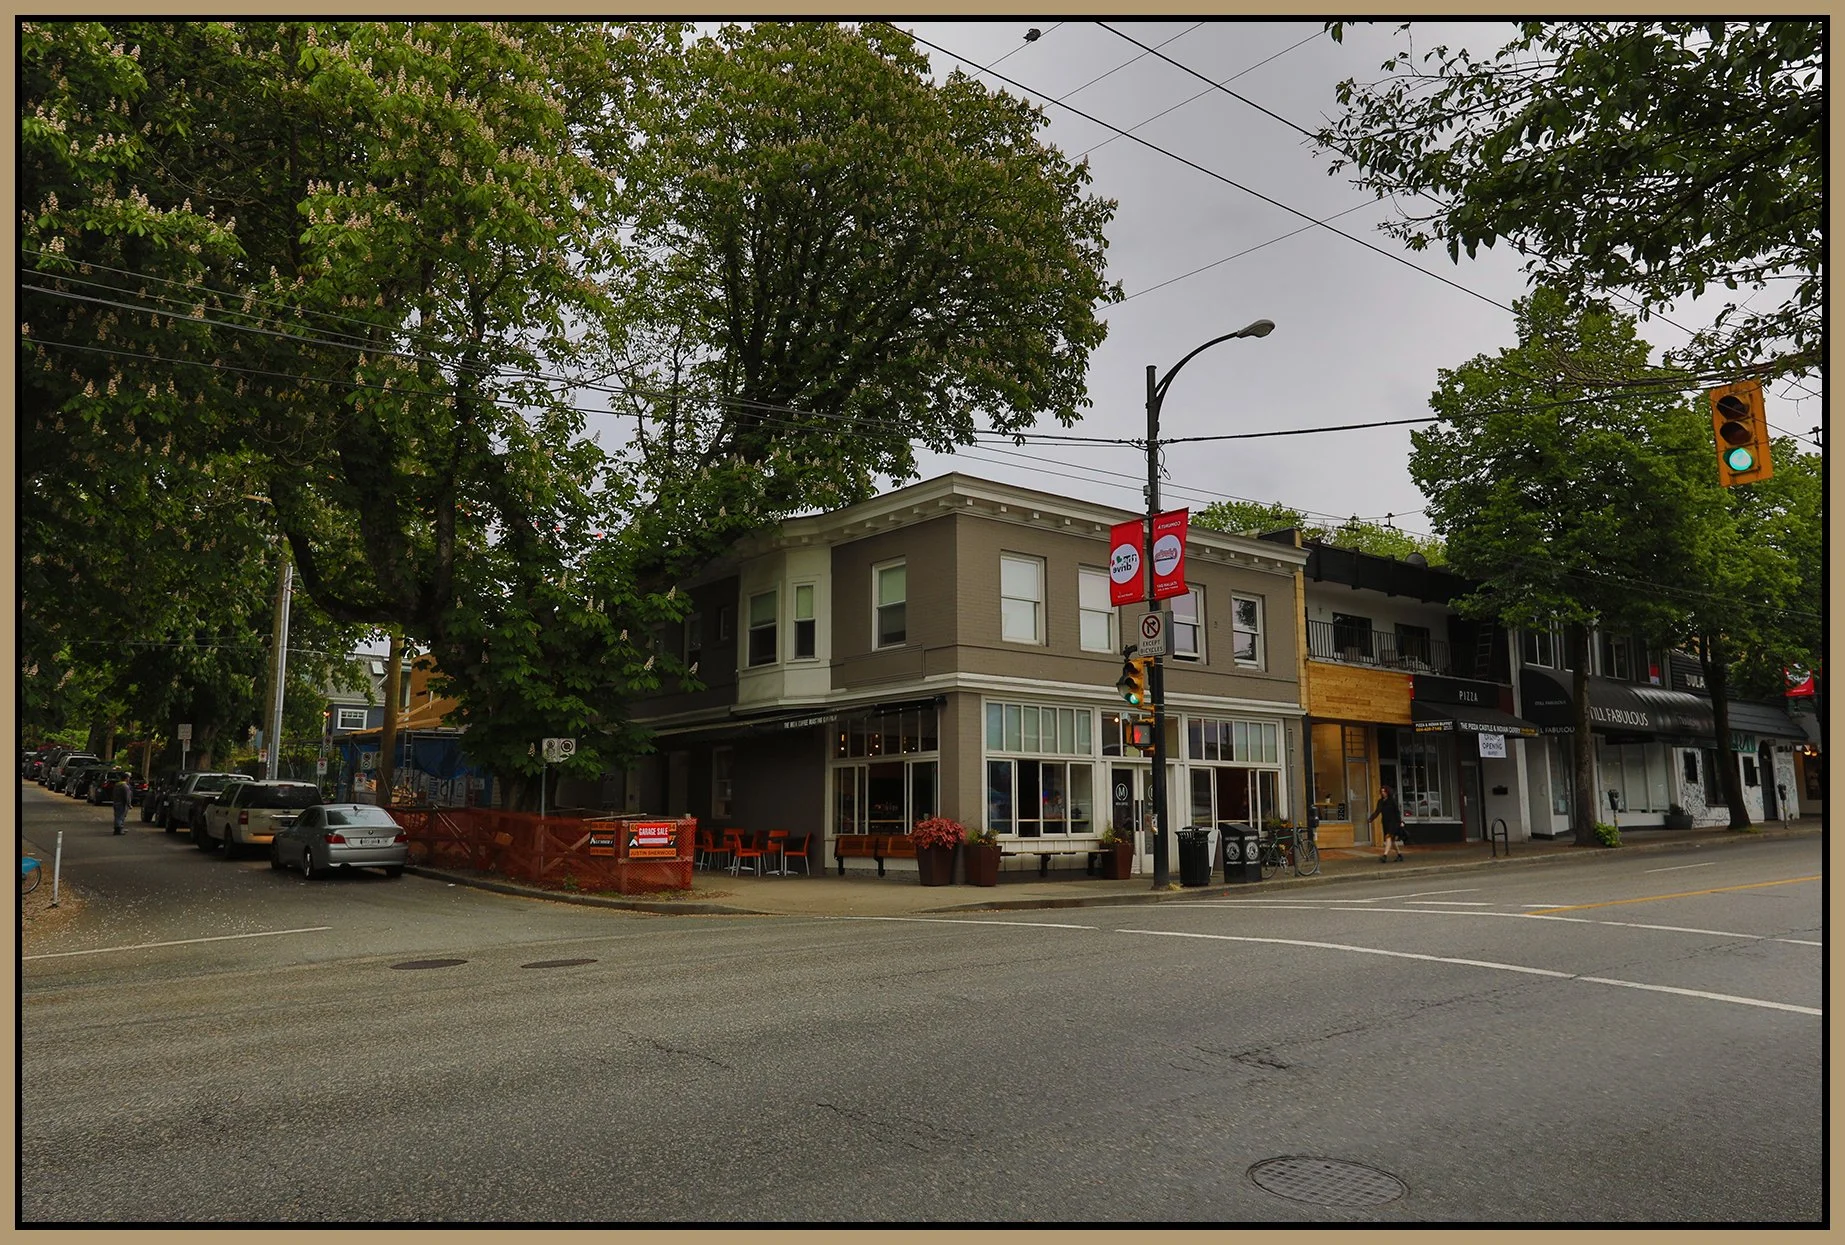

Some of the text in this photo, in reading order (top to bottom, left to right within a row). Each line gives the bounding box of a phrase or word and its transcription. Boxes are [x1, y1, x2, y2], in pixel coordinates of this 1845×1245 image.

[1459, 690, 1478, 702] PIZZA
[1590, 706, 1648, 727] TILL FABULOUS
[1545, 726, 1576, 734] FABULOU
[639, 827, 656, 835] GARAGE
[657, 827, 668, 835] SALE
